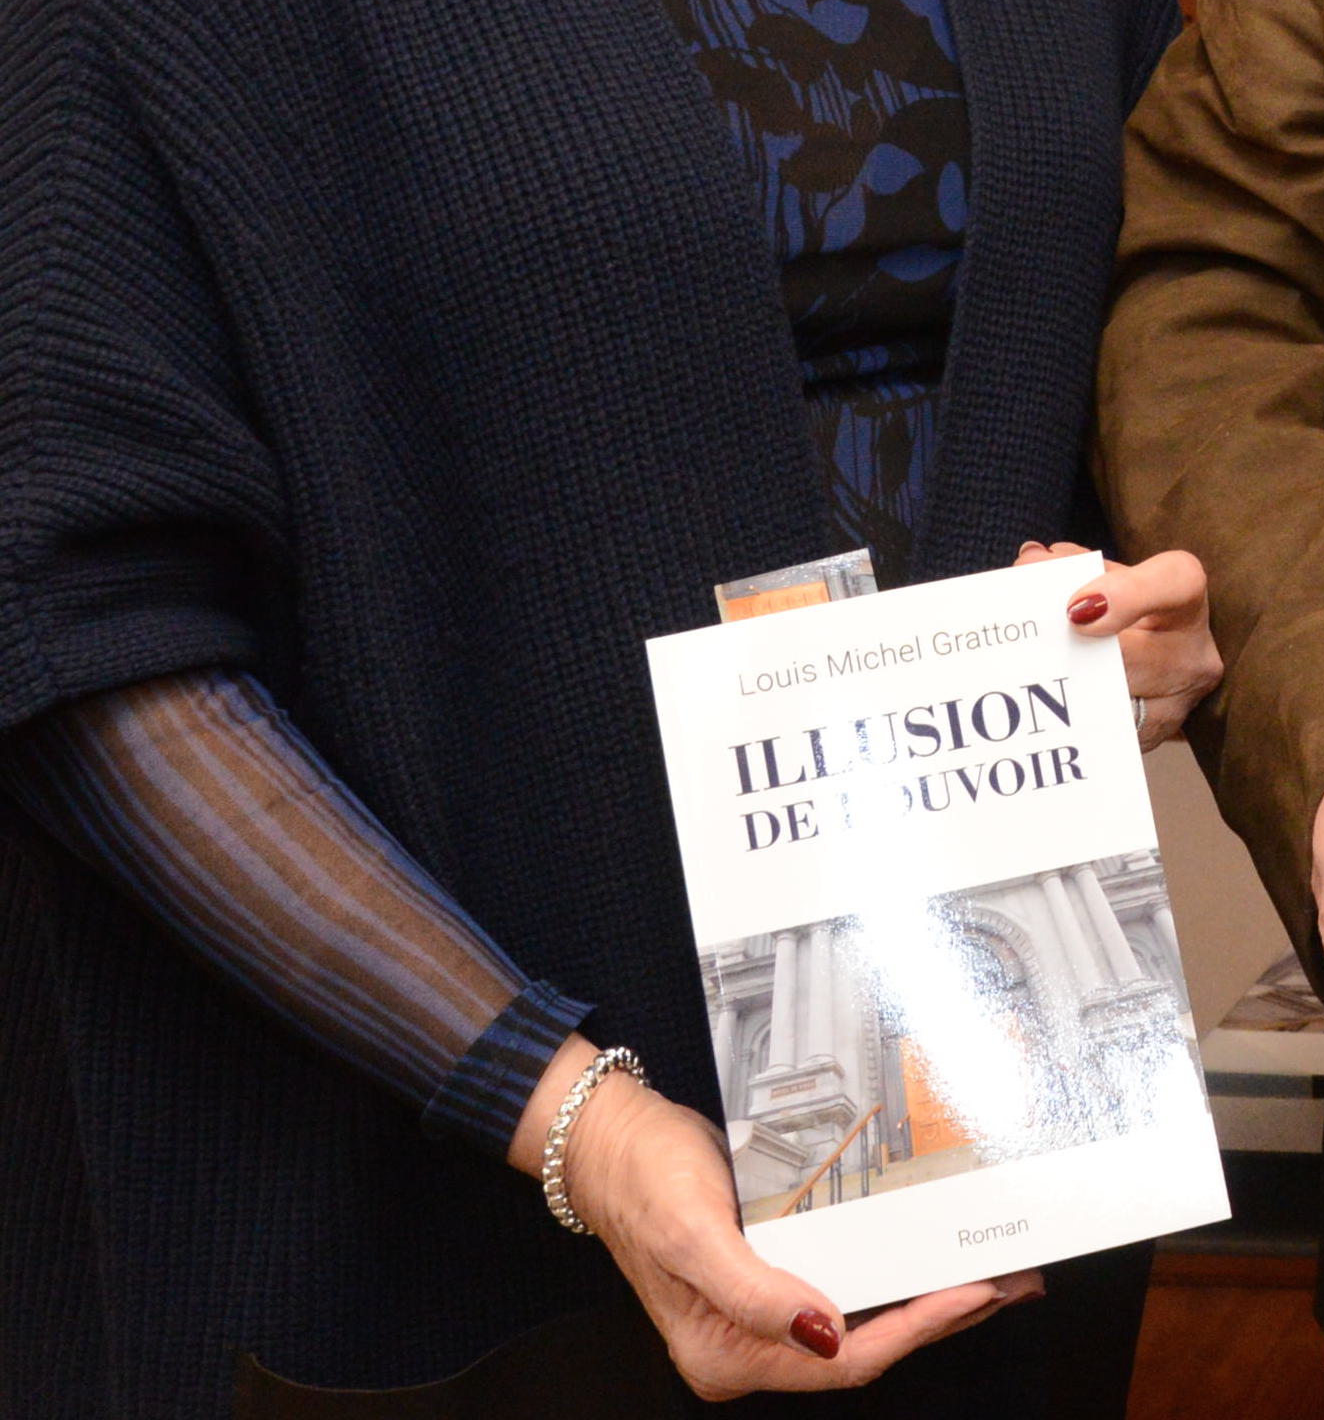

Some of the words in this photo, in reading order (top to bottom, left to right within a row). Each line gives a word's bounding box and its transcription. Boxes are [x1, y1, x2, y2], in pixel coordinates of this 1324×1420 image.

[739, 661, 817, 696] Louis
[827, 636, 922, 677] Michel
[933, 620, 1038, 655] Gratton
[728, 677, 1071, 796] ILLUSION
[740, 800, 819, 852] DE
[958, 1219, 1029, 1248] Roman
